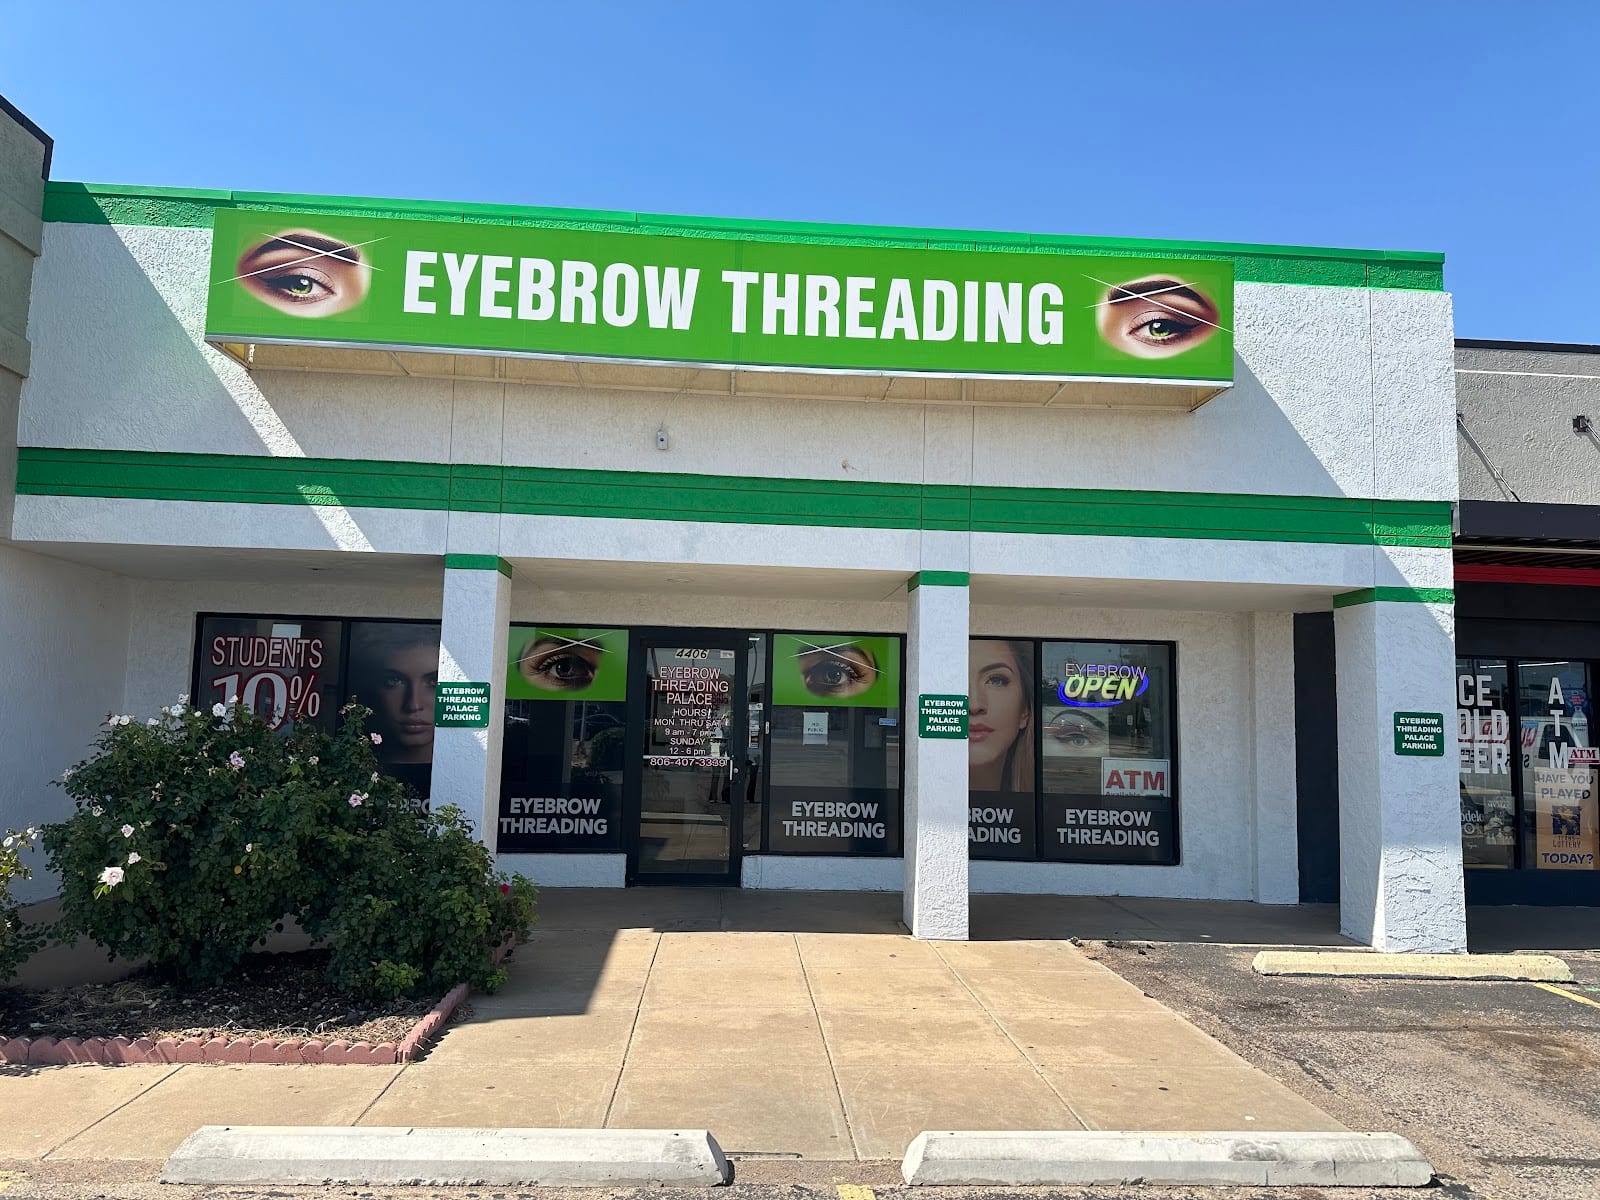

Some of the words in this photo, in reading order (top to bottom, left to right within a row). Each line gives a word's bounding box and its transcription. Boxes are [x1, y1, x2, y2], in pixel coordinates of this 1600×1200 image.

[403, 250, 700, 331] EYEBROW
[721, 270, 1064, 345] THREADING
[211, 635, 323, 669] STUDENTS
[676, 649, 708, 659] 4406
[660, 666, 721, 680] EYEBROW
[1065, 663, 1146, 680] EYEBROW
[442, 687, 485, 695] EYEBROW
[652, 679, 729, 693] THREADING
[1064, 674, 1139, 700] OPEN
[437, 696, 488, 704] THREADING
[666, 692, 713, 705] PALACE
[924, 699, 964, 707] EYEBROW
[442, 713, 481, 721] PARKING
[673, 708, 707, 717] HOURS
[920, 708, 968, 716] THREADING
[654, 718, 675, 726] MON
[679, 719, 704, 727] THRU
[928, 716, 960, 724] PALACE
[1399, 717, 1439, 725] EYEBROW
[664, 728, 671, 736] 9
[692, 728, 698, 736] 7
[925, 725, 962, 733] PARKING
[1396, 725, 1442, 733] THREADING
[670, 737, 706, 746] SUNDAY
[1404, 734, 1435, 742] PALACE
[1401, 742, 1437, 750] PARKING
[669, 747, 679, 755] 12
[686, 747, 692, 755] 6
[693, 748, 706, 757] pm
[1570, 748, 1597, 759] ATM
[1105, 769, 1165, 791] ATM
[1537, 774, 1566, 784] HAVE
[1570, 775, 1594, 785] YOU
[1540, 788, 1591, 800] PLAYED
[510, 797, 602, 815] EYEBROW
[791, 801, 879, 819] EYEBROW
[1065, 808, 1152, 827] EYEBROW
[499, 817, 608, 835] THREADING
[782, 820, 886, 839] THREADING
[1056, 828, 1160, 847] THREADING
[1541, 852, 1594, 865] TODAY?
